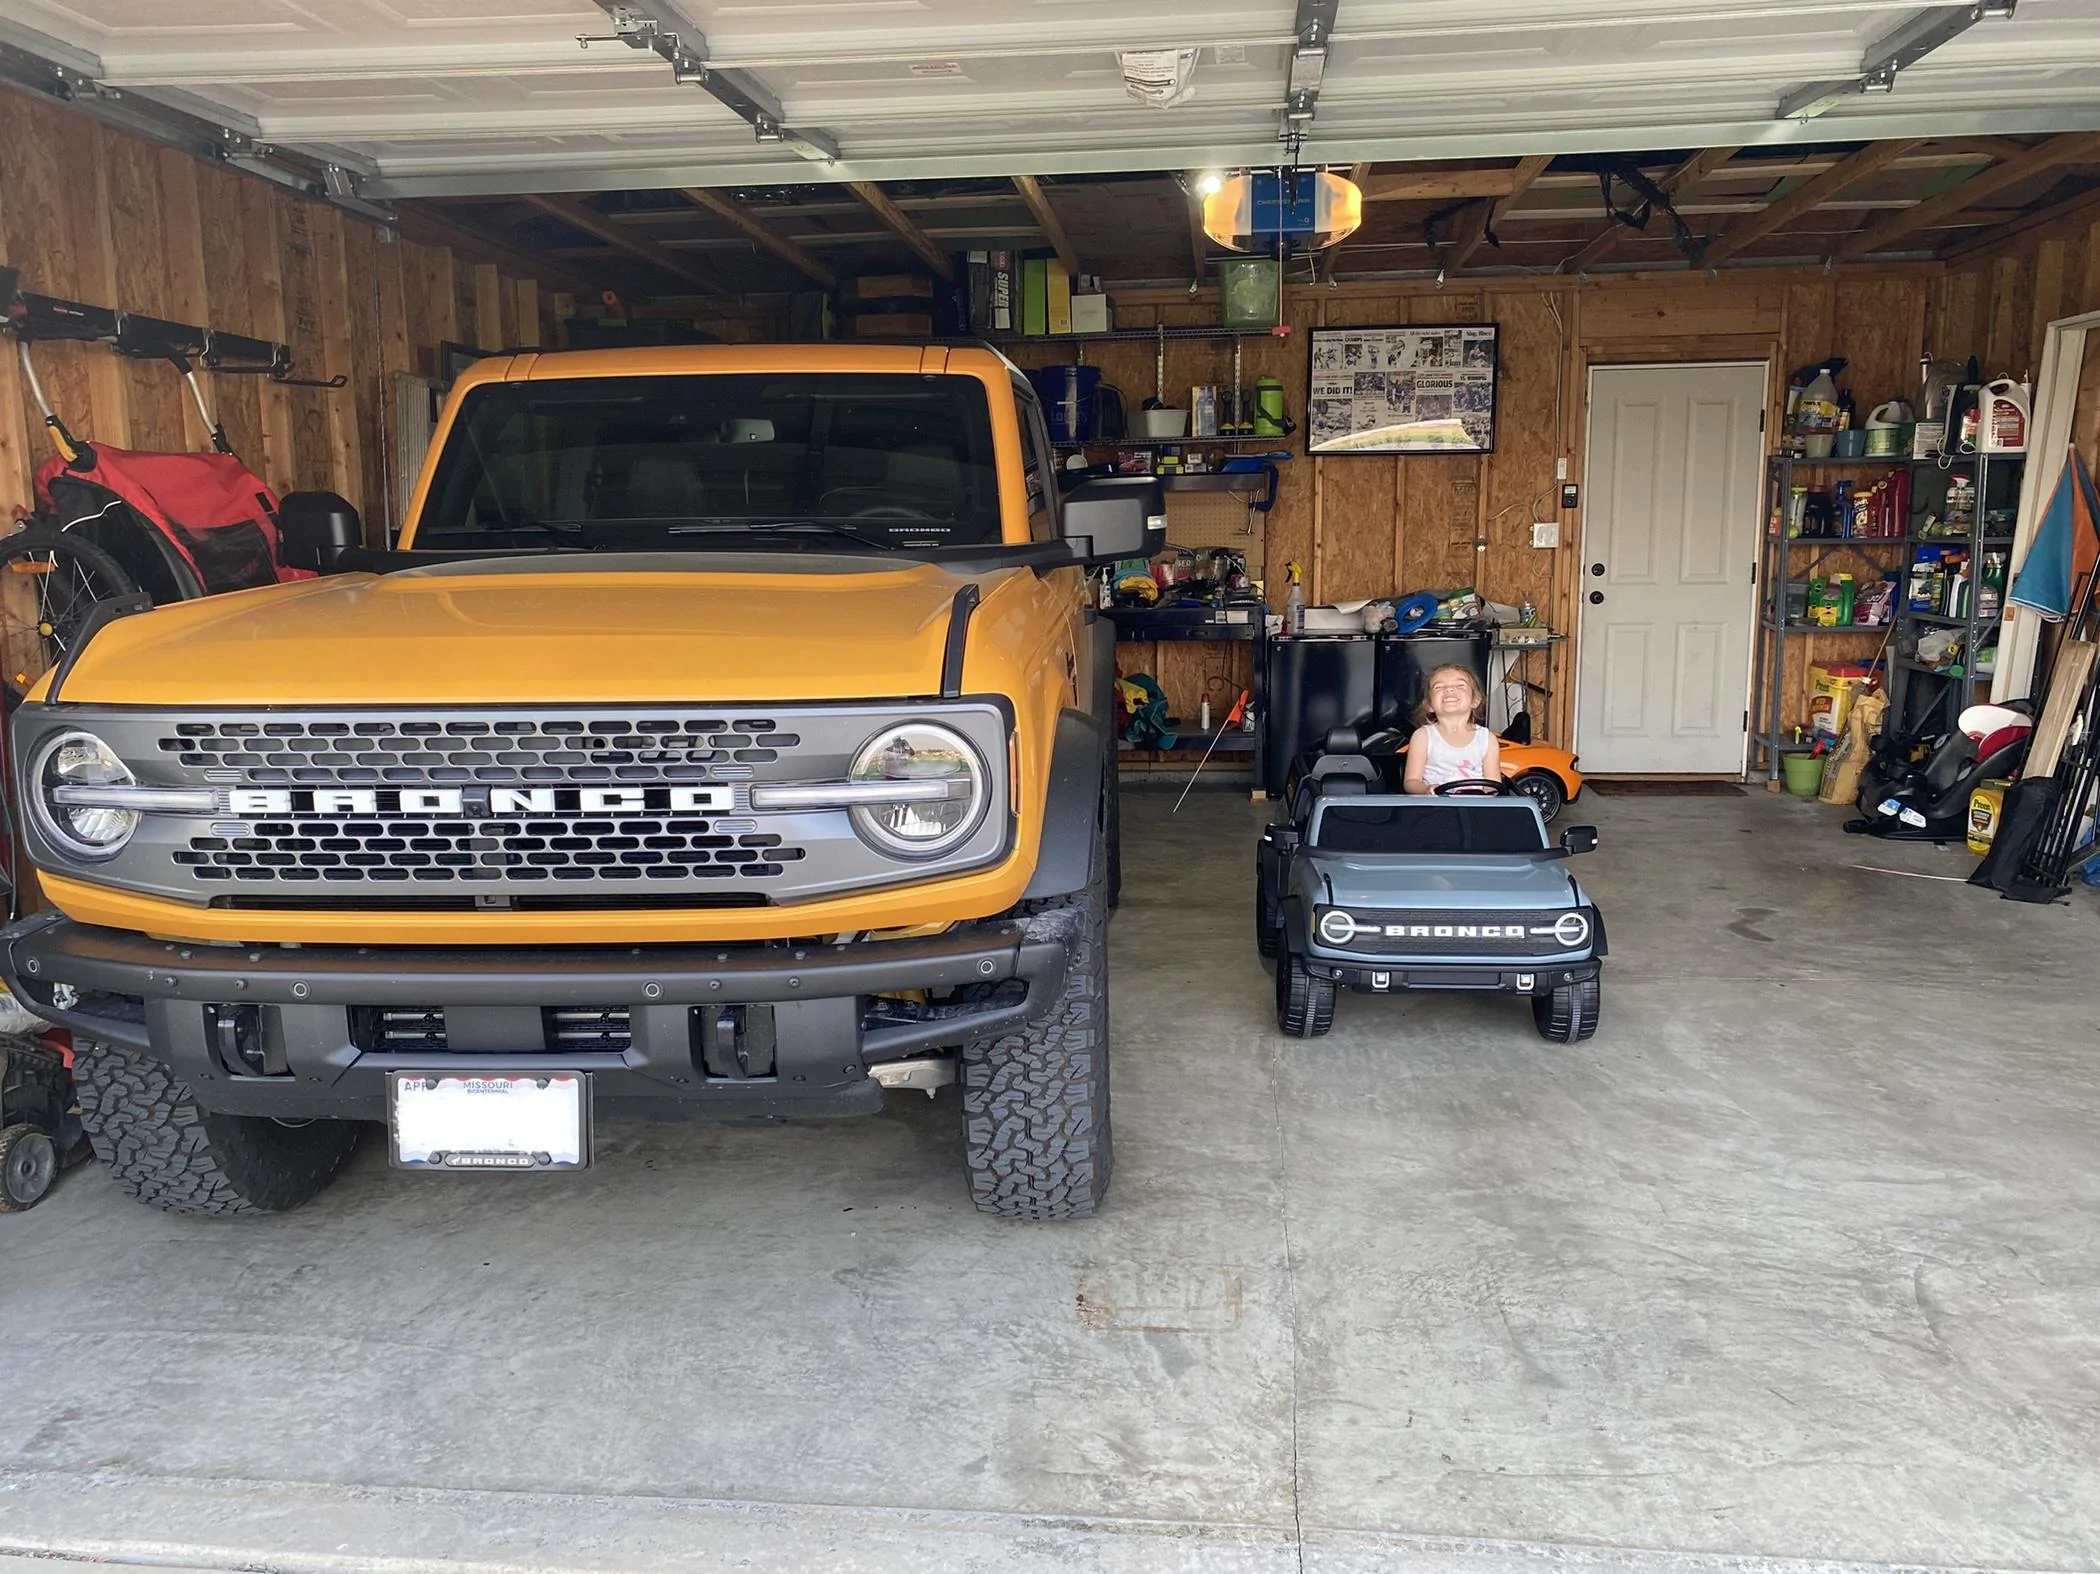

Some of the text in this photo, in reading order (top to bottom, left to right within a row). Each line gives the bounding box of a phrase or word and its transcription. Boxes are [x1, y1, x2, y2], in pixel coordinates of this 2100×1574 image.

[997, 271, 1009, 308] SUPER
[1416, 380, 1453, 388] GLORIOUS
[1313, 386, 1353, 395] WE DID IT!
[229, 785, 735, 813] BRONCO
[1385, 925, 1525, 938] BRONCO
[463, 1081, 513, 1089] MISSOURI
[461, 1157, 529, 1165] BRONCO
